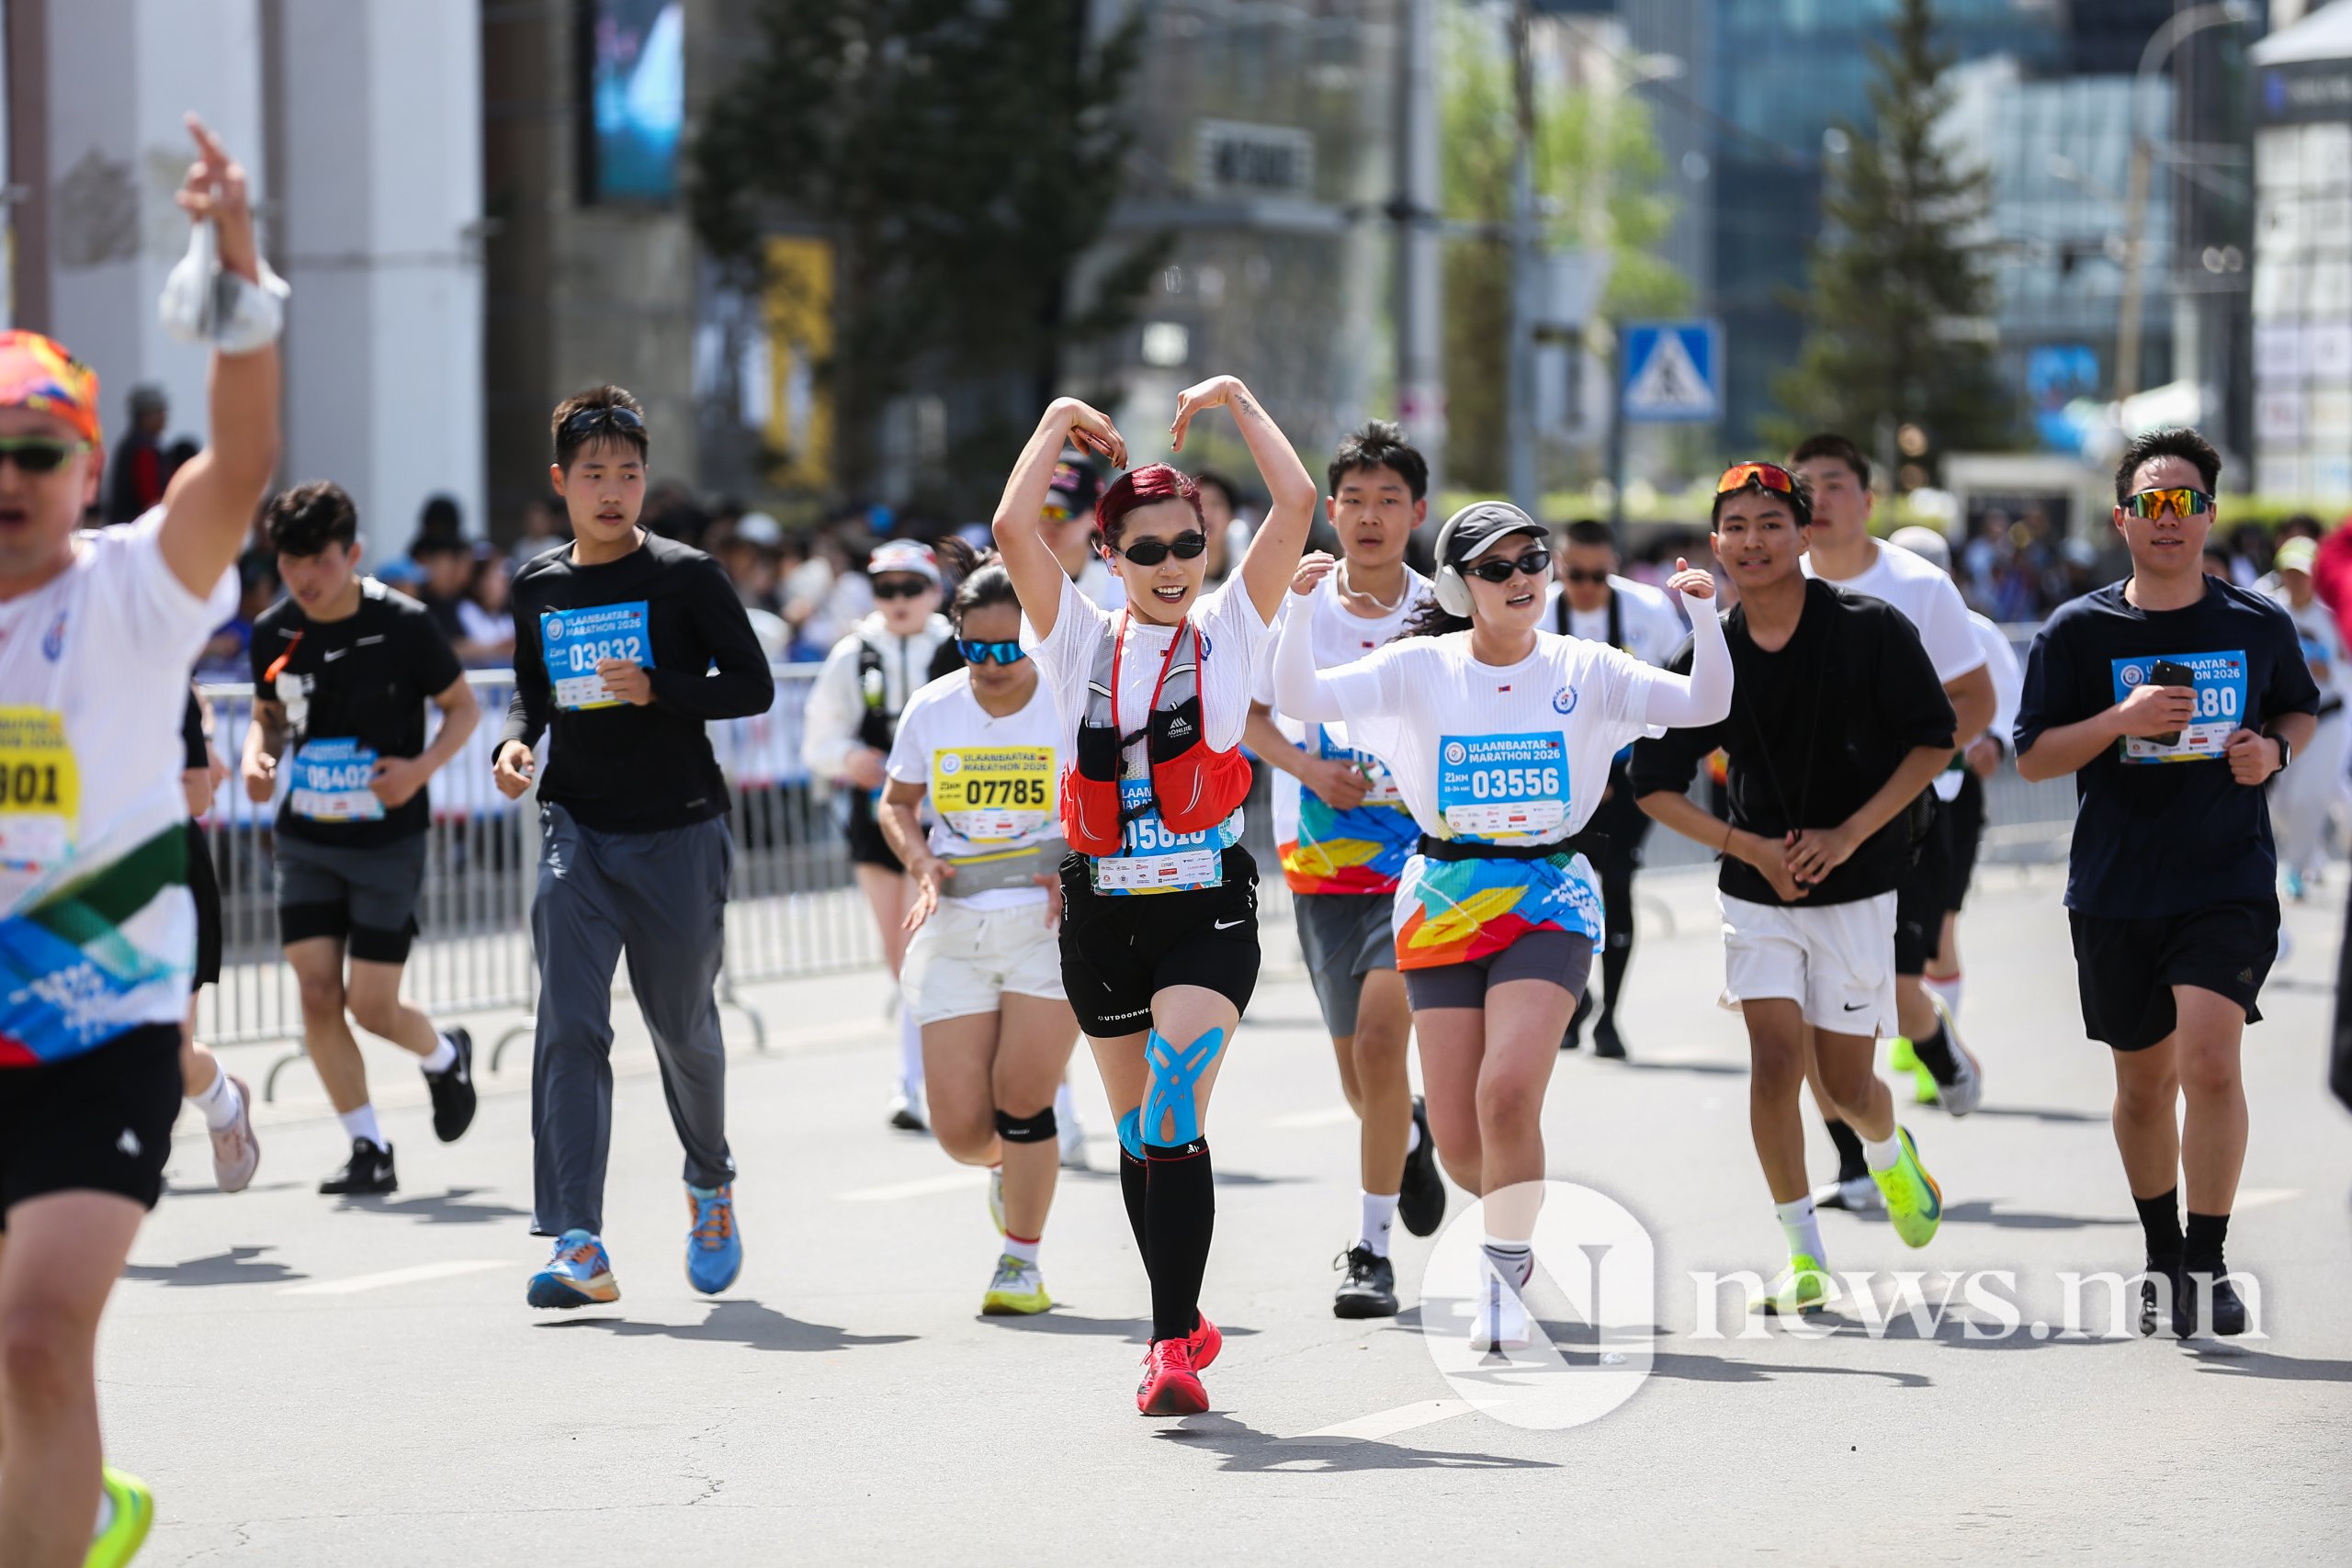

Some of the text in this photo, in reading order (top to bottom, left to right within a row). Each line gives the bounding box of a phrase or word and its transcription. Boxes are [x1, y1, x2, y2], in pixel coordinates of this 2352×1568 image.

[570, 636, 642, 671] 03832
[2213, 669, 2240, 679] 2026
[2190, 687, 2236, 717] 180
[1469, 739, 1547, 753] ULAANBAATAR
[1469, 750, 1560, 763] MARATHON 2026
[967, 779, 1045, 805] 07785
[1472, 767, 1559, 798] 03556
[1098, 1008, 1152, 1021] OUTDOORWE
